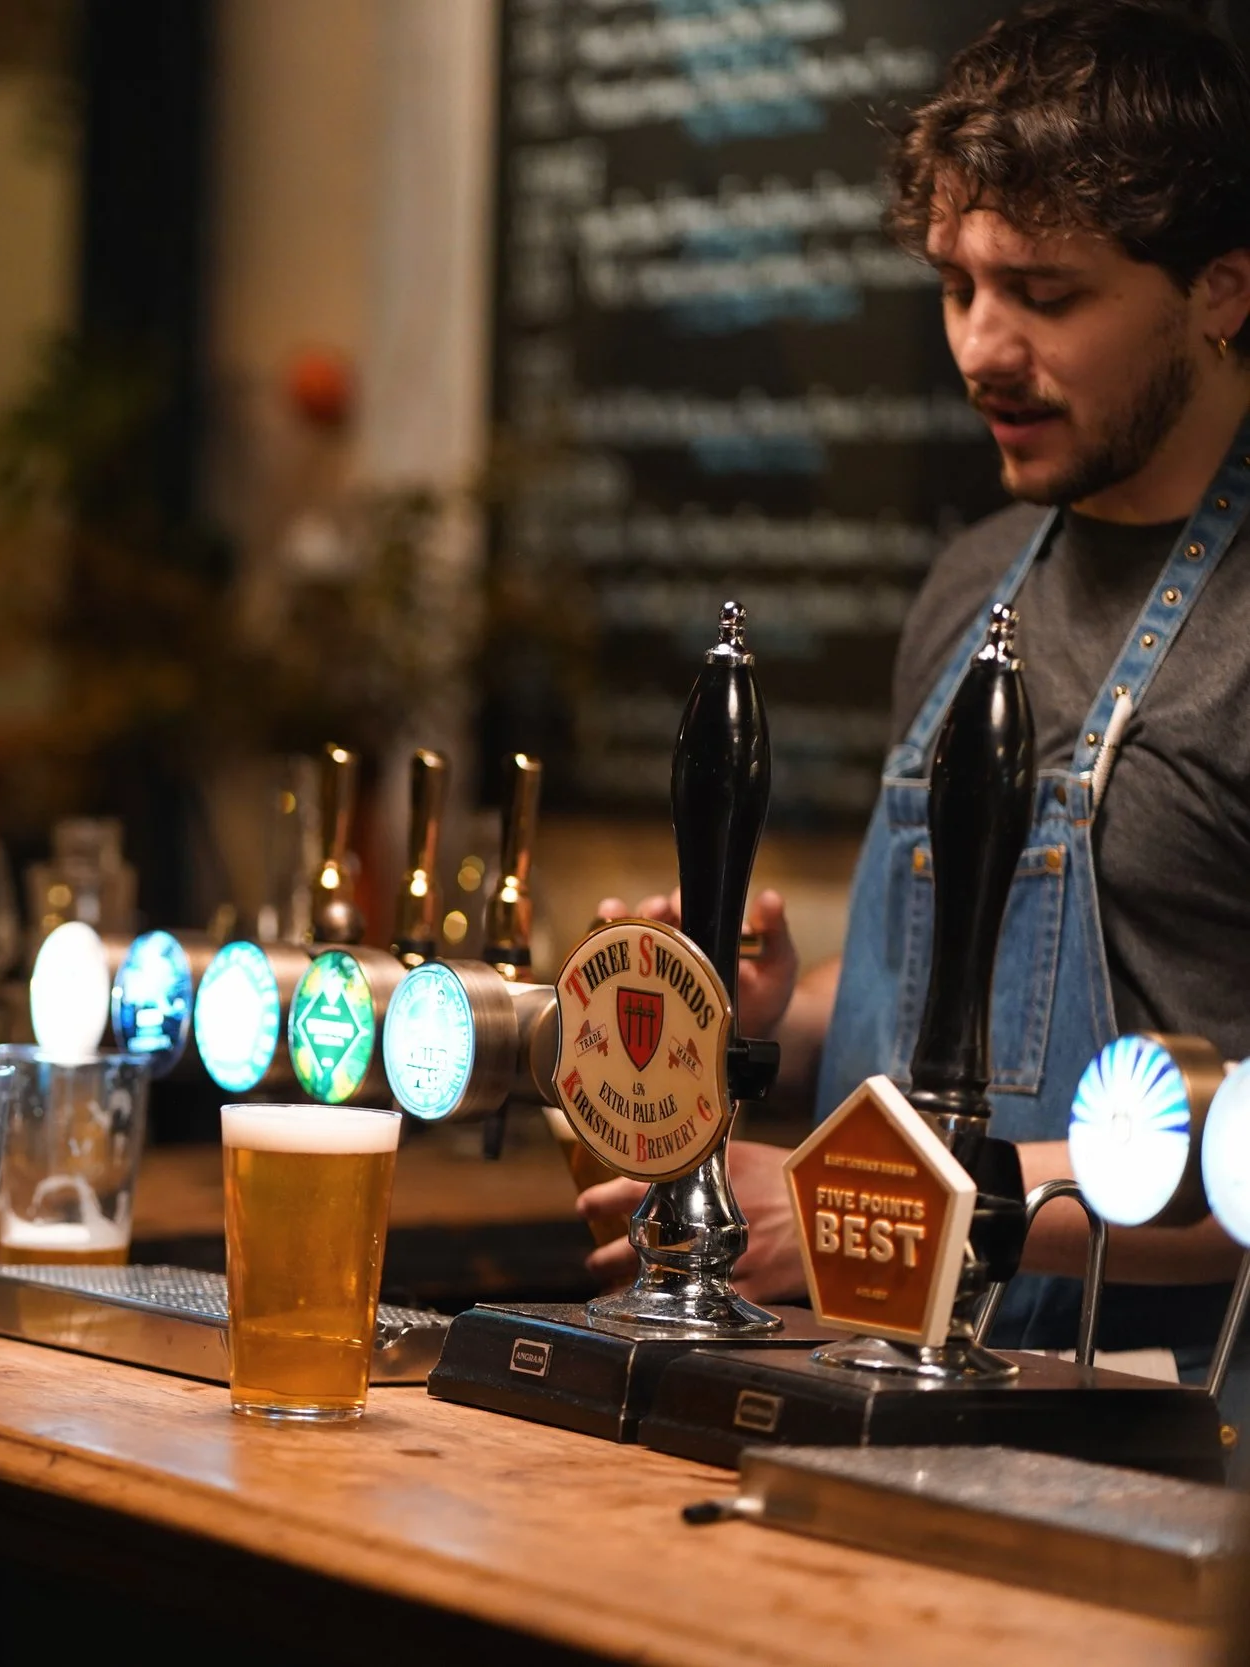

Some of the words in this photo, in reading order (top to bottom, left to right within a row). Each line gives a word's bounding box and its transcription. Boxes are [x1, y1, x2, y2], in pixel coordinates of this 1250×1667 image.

[565, 940, 630, 1011] THREE
[639, 933, 715, 1031] SWORDS
[579, 1030, 603, 1052] TRADE
[676, 1045, 697, 1072] MARK
[562, 1066, 630, 1156] KIRKSTALL
[636, 1116, 698, 1163] BREWERY
[599, 1080, 630, 1120] EXTRA
[633, 1103, 655, 1123] PALE
[659, 1094, 678, 1120] ALE
[816, 1187, 855, 1210] FIVE
[859, 1193, 926, 1219] POINTS
[815, 1211, 926, 1268] BEST
